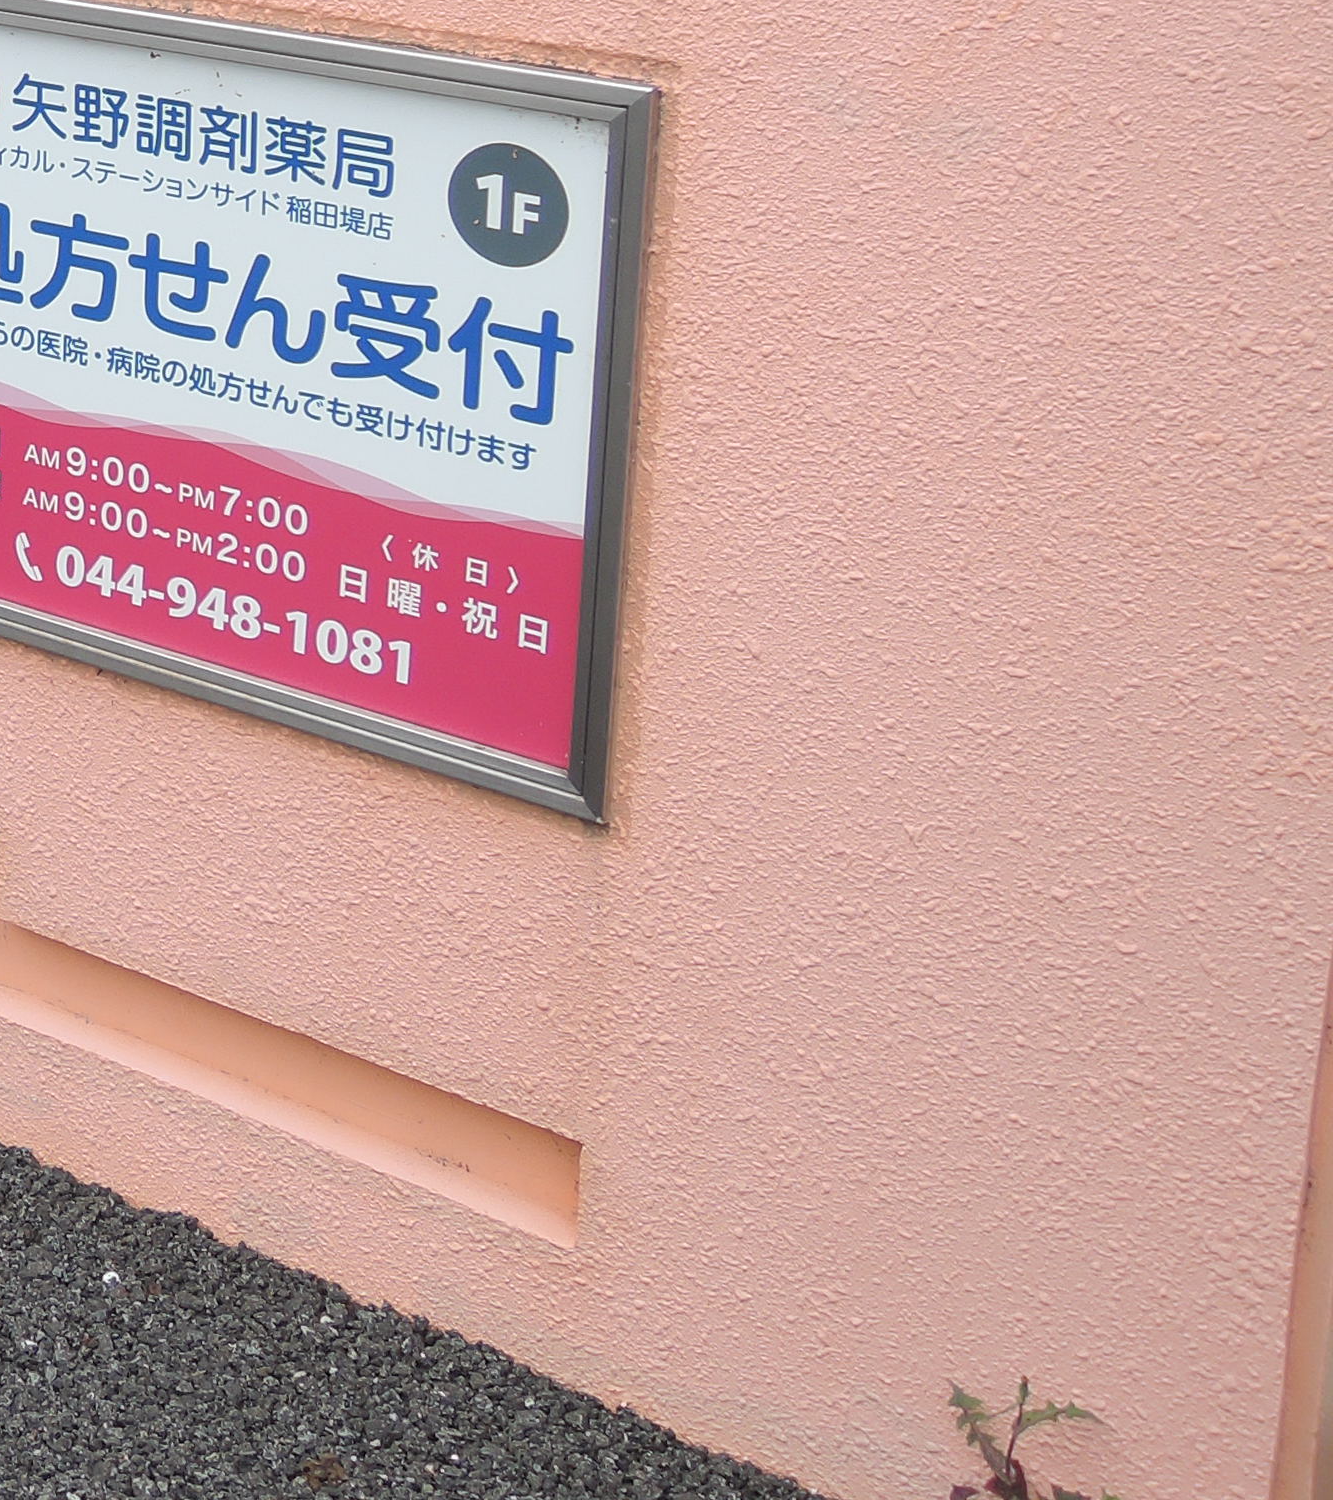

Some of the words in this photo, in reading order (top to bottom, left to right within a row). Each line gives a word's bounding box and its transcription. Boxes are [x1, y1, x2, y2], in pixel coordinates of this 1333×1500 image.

[11, 73, 395, 199] 矢野調剤薬局
[286, 194, 394, 241] 稲田堤店
[475, 172, 542, 237] 1F
[55, 543, 414, 686] 044-948-1081
